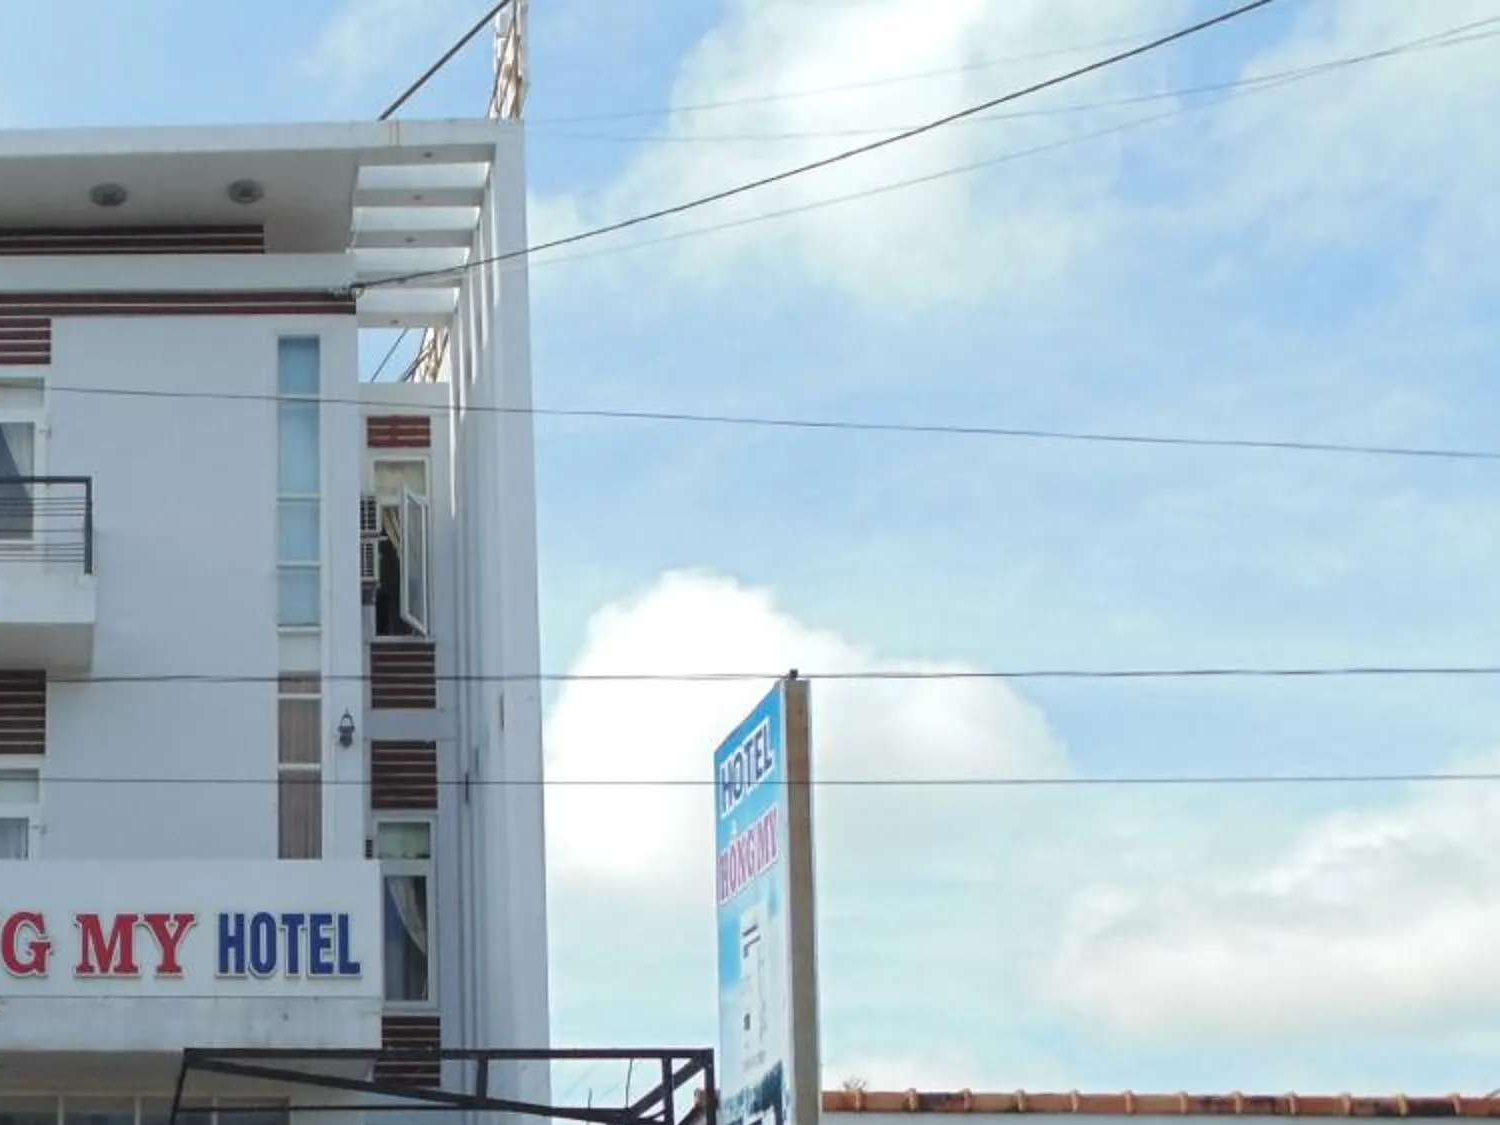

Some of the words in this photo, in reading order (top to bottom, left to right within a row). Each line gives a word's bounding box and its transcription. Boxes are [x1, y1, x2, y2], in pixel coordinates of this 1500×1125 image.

[720, 721, 773, 813] HOTEL
[73, 910, 197, 978] MY
[214, 910, 362, 978] HOTEL
